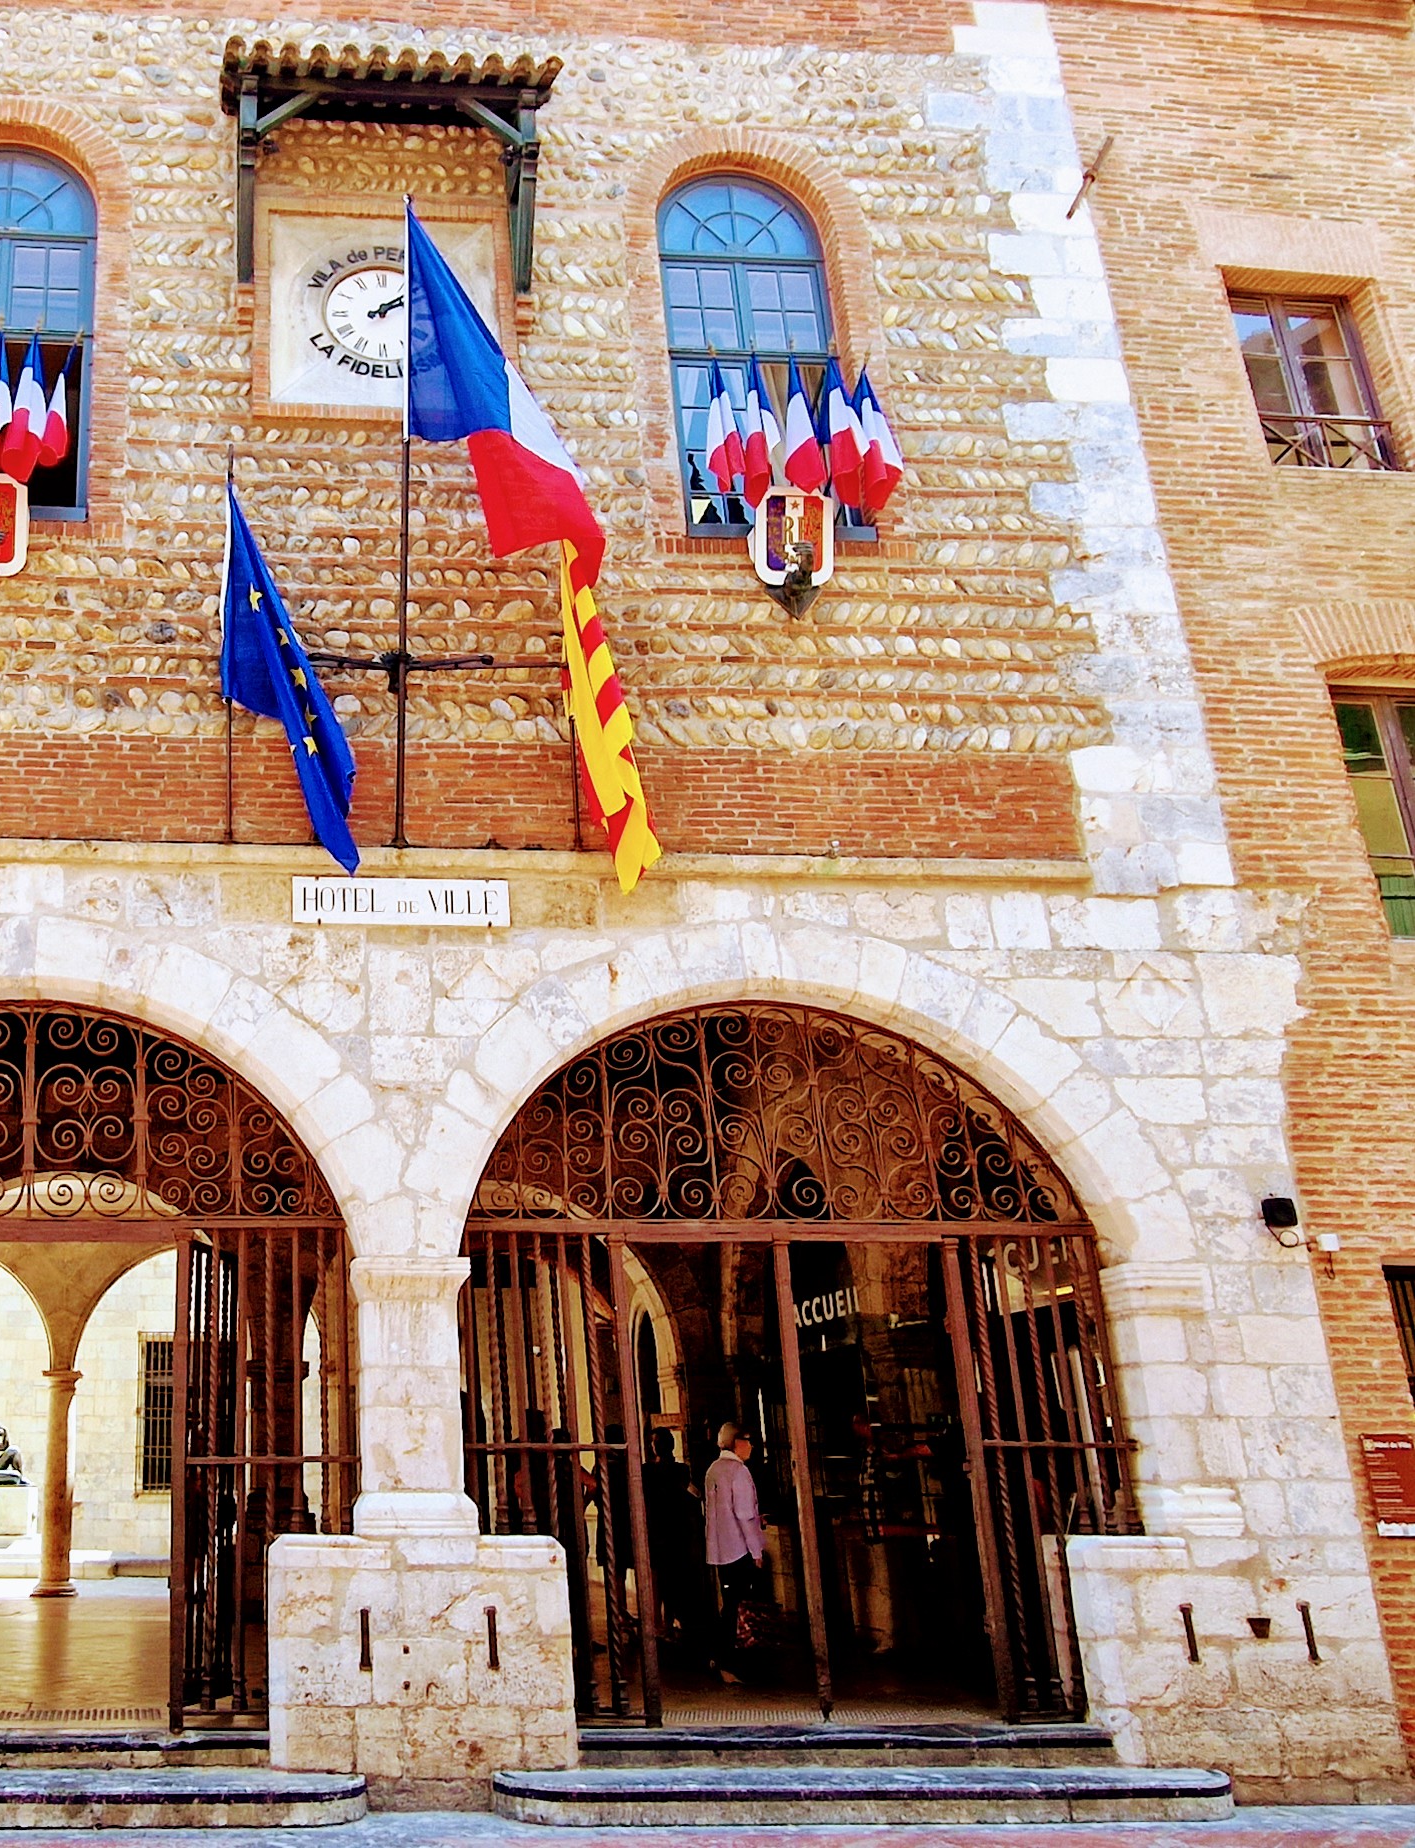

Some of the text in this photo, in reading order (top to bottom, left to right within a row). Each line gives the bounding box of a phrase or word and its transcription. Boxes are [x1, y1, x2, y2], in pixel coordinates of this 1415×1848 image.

[307, 258, 344, 290] VILA
[347, 249, 369, 264] de
[309, 332, 336, 359] LA
[302, 886, 386, 913] HOTEL
[427, 889, 499, 916] VILLE
